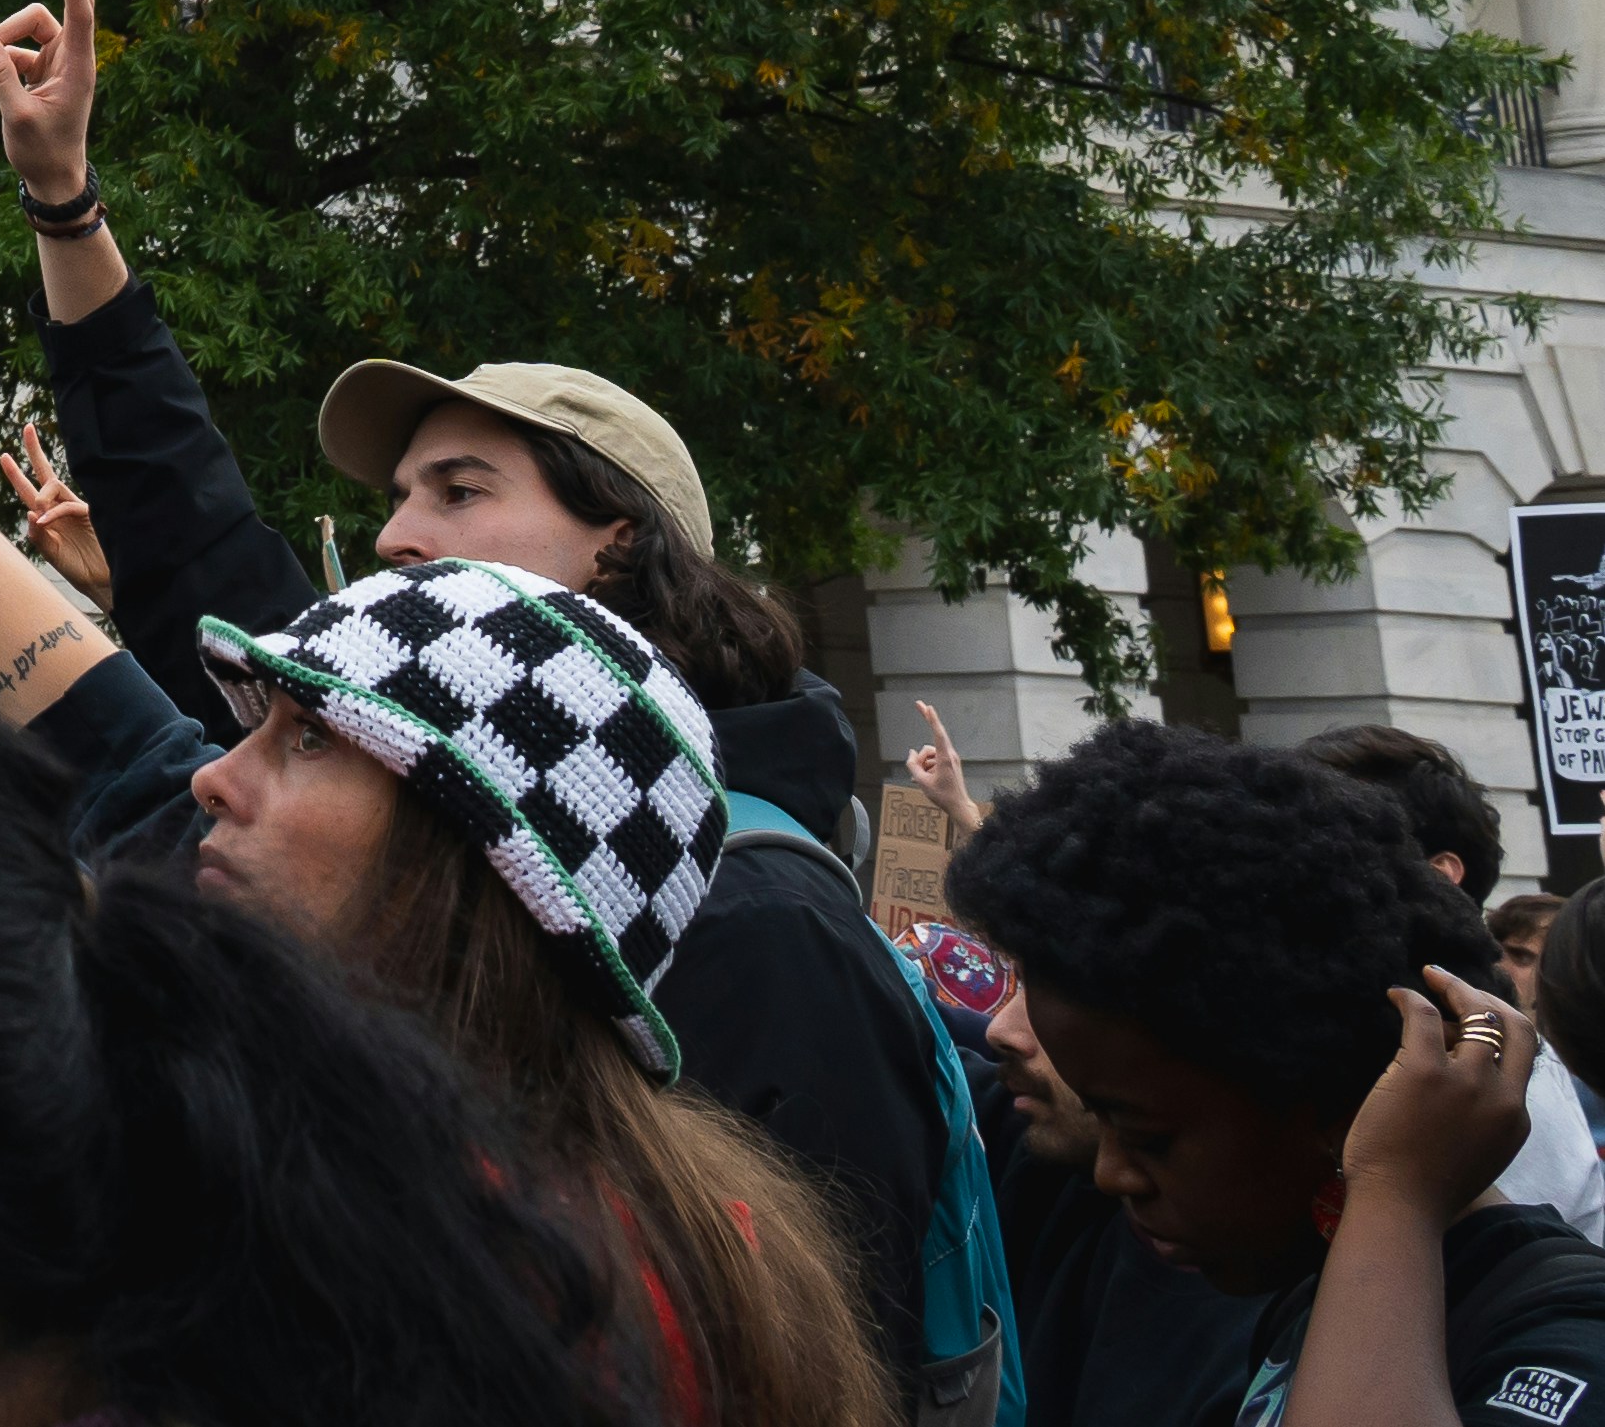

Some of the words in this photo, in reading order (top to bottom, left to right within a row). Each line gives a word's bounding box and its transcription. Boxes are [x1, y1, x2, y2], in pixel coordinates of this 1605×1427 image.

[1554, 695, 1605, 724] JEW
[1554, 726, 1590, 743] STOP
[1558, 752, 1576, 769] OF
[883, 791, 942, 843] FREE
[878, 849, 939, 906] FREE
[1528, 1371, 1560, 1389] THE
[1498, 1391, 1558, 1417] SCHOOL
[1511, 1382, 1563, 1403] BLACK
